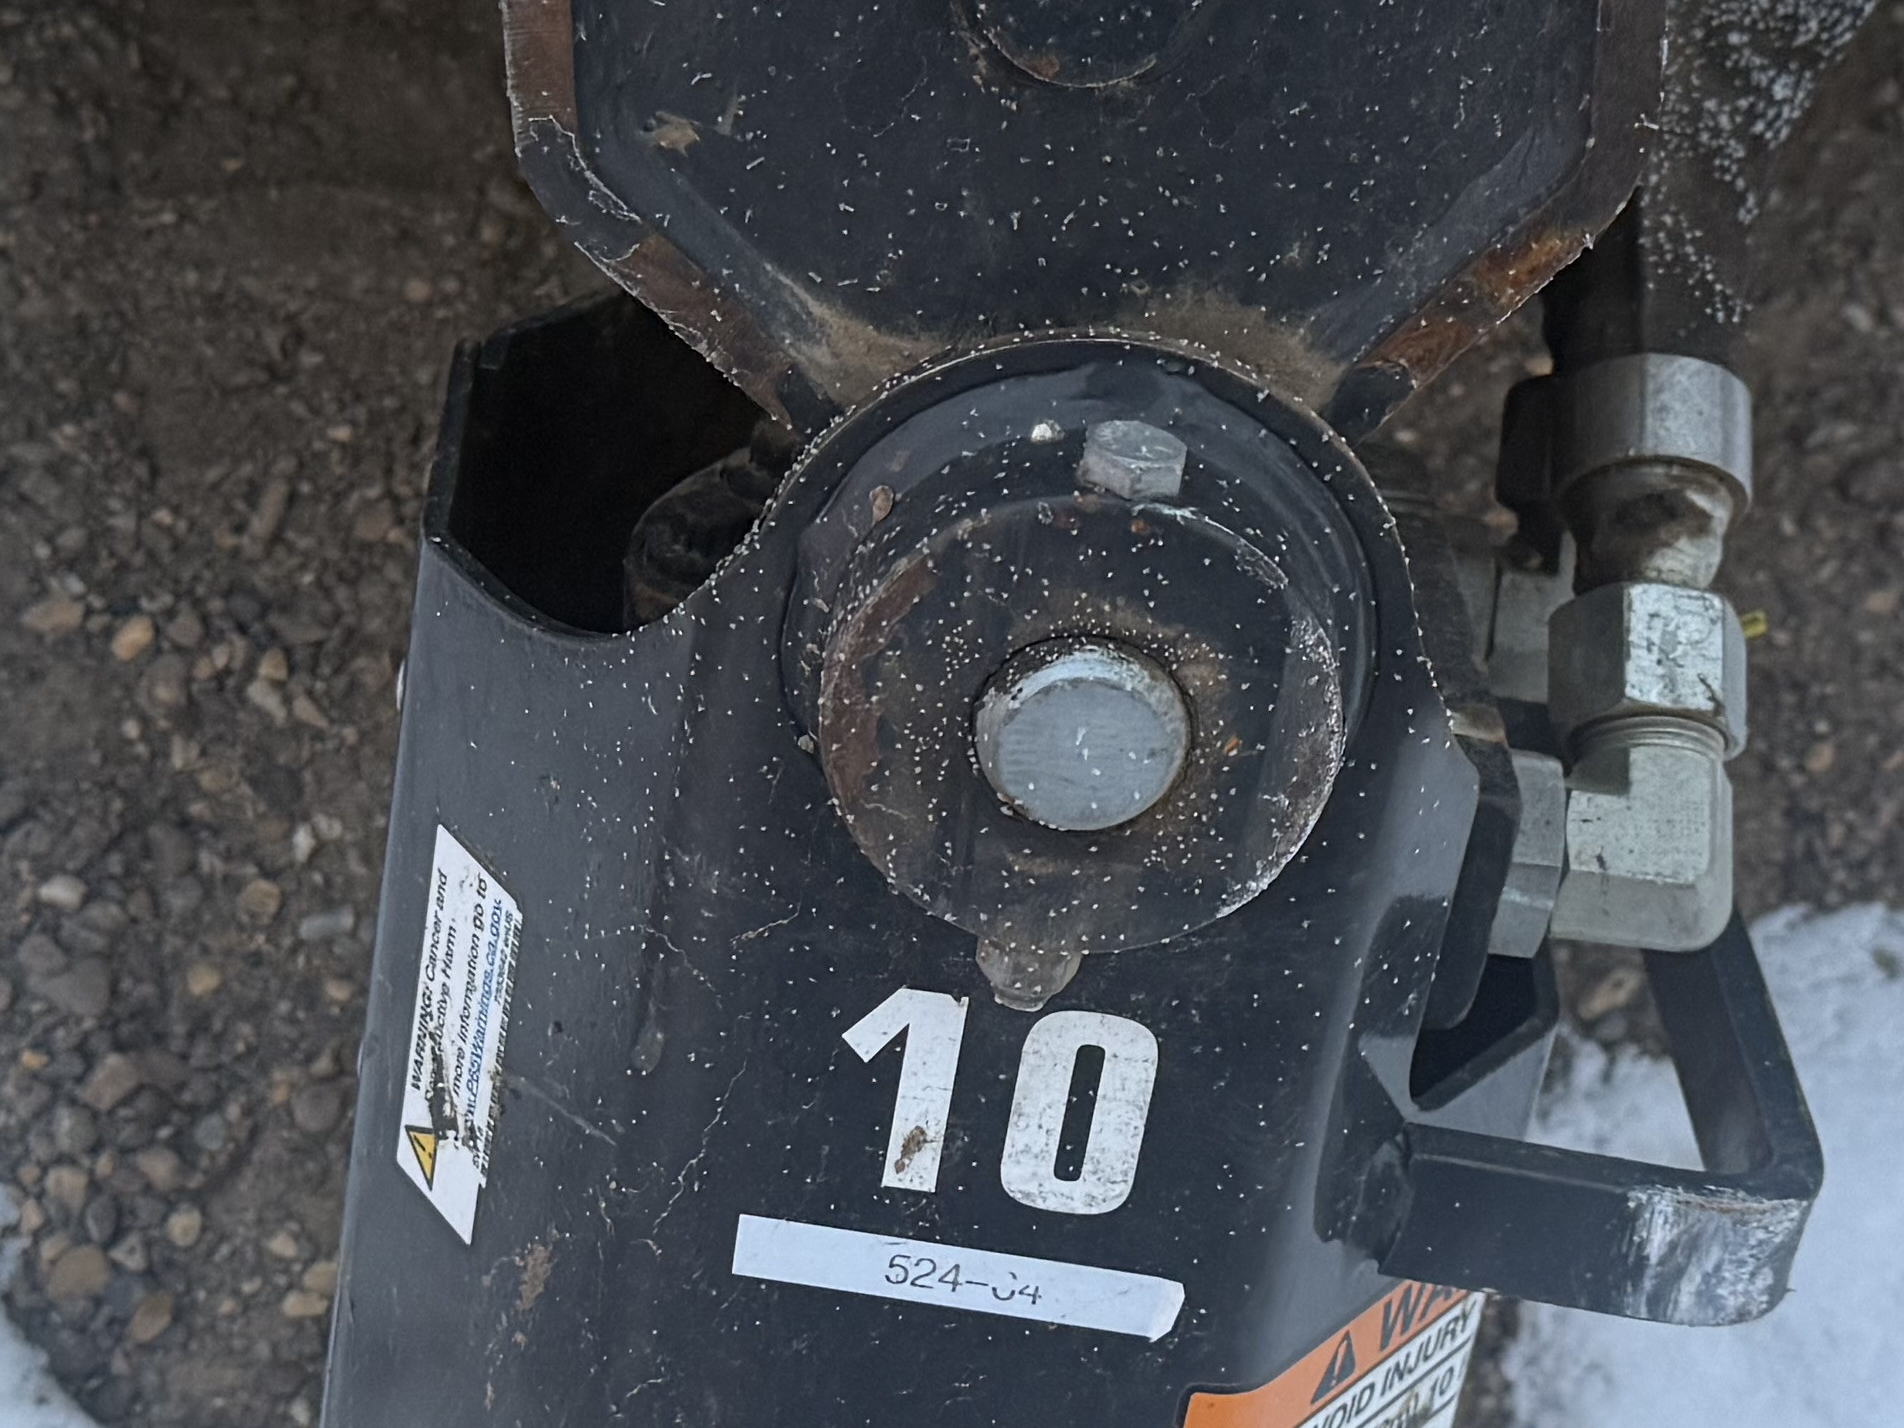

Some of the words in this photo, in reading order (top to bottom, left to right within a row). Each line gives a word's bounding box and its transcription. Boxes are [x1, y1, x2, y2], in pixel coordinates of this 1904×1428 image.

[473, 903, 484, 932] go
[477, 875, 487, 899] to
[411, 985, 433, 1091] WARNING:
[425, 910, 442, 982] Cancer
[437, 868, 447, 910] and
[441, 925, 456, 980] Harm
[457, 933, 480, 1044] information
[453, 1047, 465, 1097] more
[842, 986, 1159, 1215] 10
[1380, 1300, 1476, 1397] INJURY
